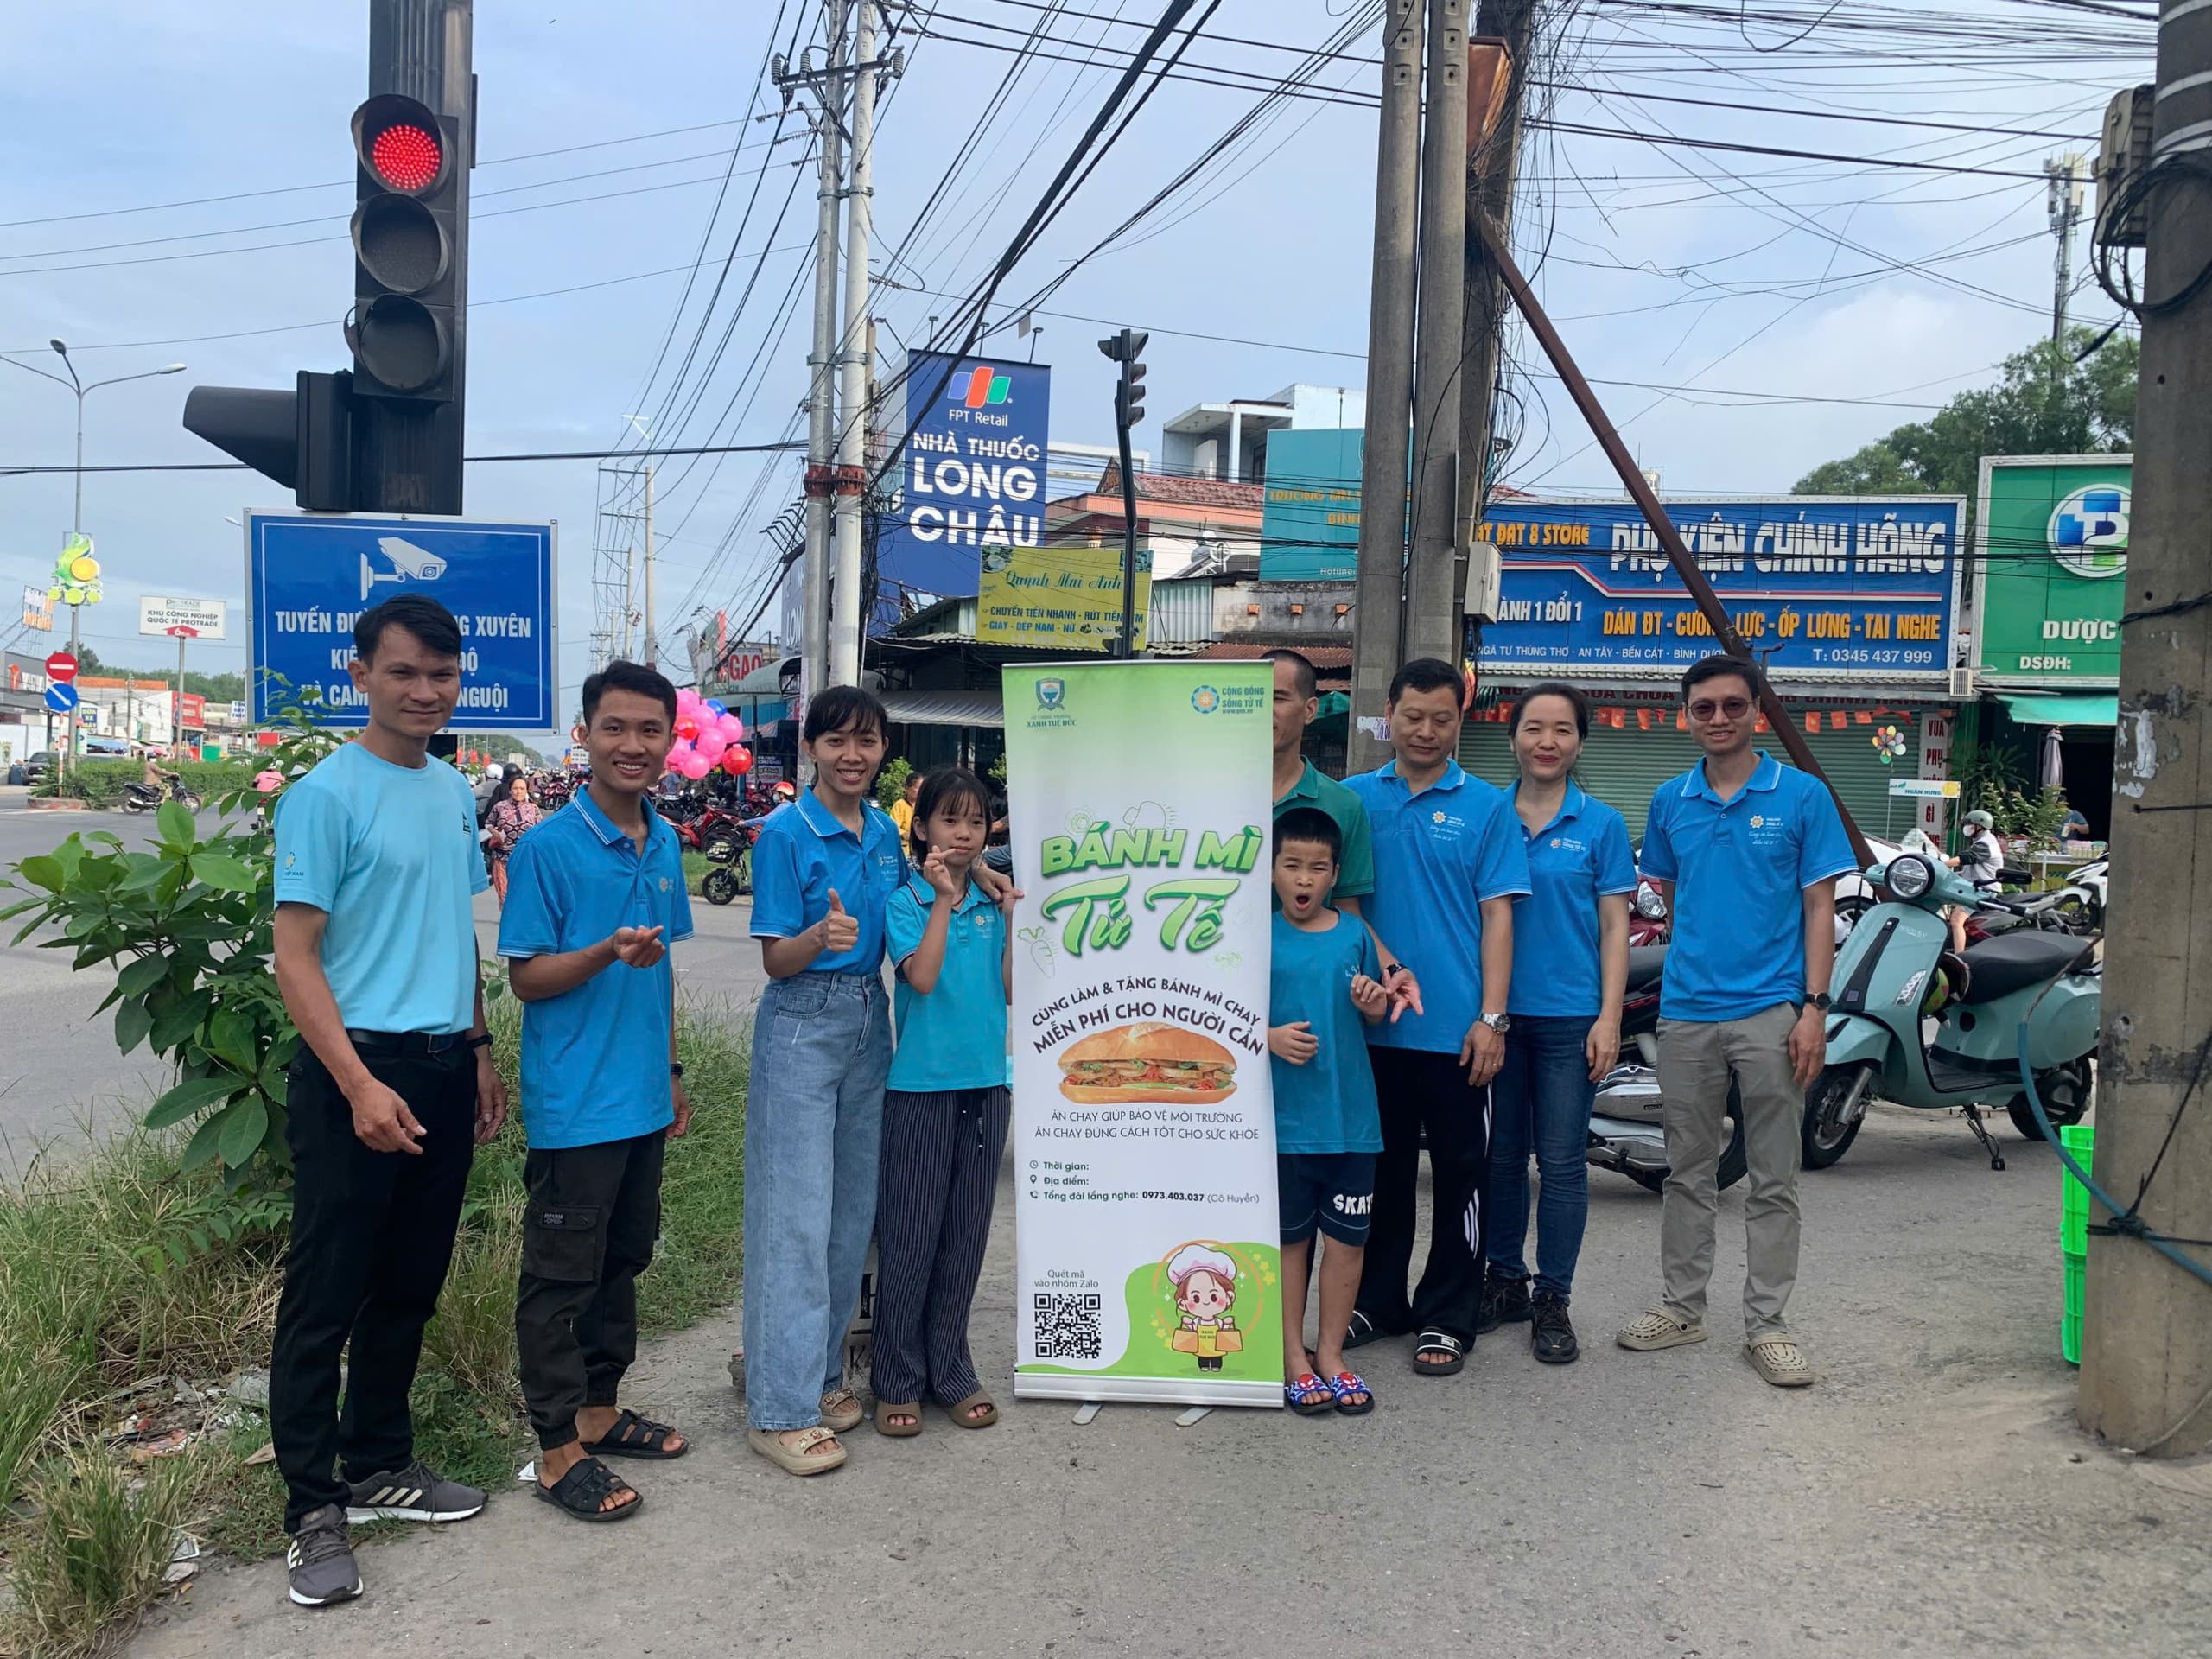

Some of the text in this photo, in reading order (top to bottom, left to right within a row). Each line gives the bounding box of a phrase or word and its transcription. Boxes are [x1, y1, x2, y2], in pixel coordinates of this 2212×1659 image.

[949, 409, 1008, 427] FPT Retail
[913, 430, 1040, 461] NHÀ THUỐC
[913, 456, 1038, 501] LONG
[909, 504, 1039, 547] CHÂU
[1529, 524, 1540, 545] 8
[1542, 523, 1591, 546] STORE
[1611, 511, 1946, 582] PHỤ KIỆN CHÍNH HÃNG
[1054, 572, 1083, 588] Mai
[1089, 575, 1123, 590] Anh
[990, 605, 1024, 618] CHUYỂN
[1046, 609, 1076, 620] NHANH
[1084, 609, 1101, 621] RÚT
[1497, 590, 1582, 622] ÀNH 1 ĐỔI 1
[181, 619, 218, 627] PROTRADE
[276, 605, 332, 633] TUYẾN
[475, 612, 531, 638] XUYÊN
[1035, 622, 1055, 632] NAM
[1604, 607, 1636, 635] DÁN
[1642, 612, 1663, 636] ĐT
[1735, 610, 1765, 641] LỰC
[1777, 606, 1800, 638] ỐP
[1807, 609, 1851, 639] LƯNG
[1865, 613, 1891, 639] TAI
[1897, 614, 1942, 640] NGHE
[2043, 618, 2117, 644] DƯỢC
[1499, 646, 1513, 656] TƯ
[1516, 645, 1547, 657] THÙNG
[1578, 648, 1592, 657] AN
[1595, 647, 1613, 658] TÂY
[1622, 645, 1641, 658] BẾN
[1644, 646, 1664, 658] CÁT
[1674, 646, 1696, 658] BÌNH
[1814, 649, 1932, 664] T: 0345 437 999
[2018, 656, 2072, 671] DSĐH:
[1928, 720, 1944, 737] VUA
[1926, 748, 1943, 768] PHỤ
[1925, 802, 1935, 823] GÌ
[1041, 821, 1263, 878] BÁNH MÌ
[1041, 874, 1241, 958] Tử Tế
[1032, 975, 1261, 1027] CÙNG LÀM & TẶNG BÁNH MÌ CHAY
[1033, 1001, 1265, 1057] MIỄN PHÍ CHO NGƯỜI CẦN
[1051, 1109, 1243, 1123] ĂN CHAY GIÚP BẢO VỆ MÔI TRƯỜNG
[1035, 1126, 1259, 1140] ĂN CHAY ĐÚNG CÁCH TỐT CHO SỨC KHỎE
[1043, 1160, 1090, 1172] Thời gian:
[1043, 1175, 1090, 1185] Địa điểm:
[1043, 1191, 1260, 1204] Tổng đài lắng nghe: 0973.403.037 (Cô Huyền)
[1332, 1192, 1374, 1216] SKAT
[1047, 1269, 1069, 1279] Quét
